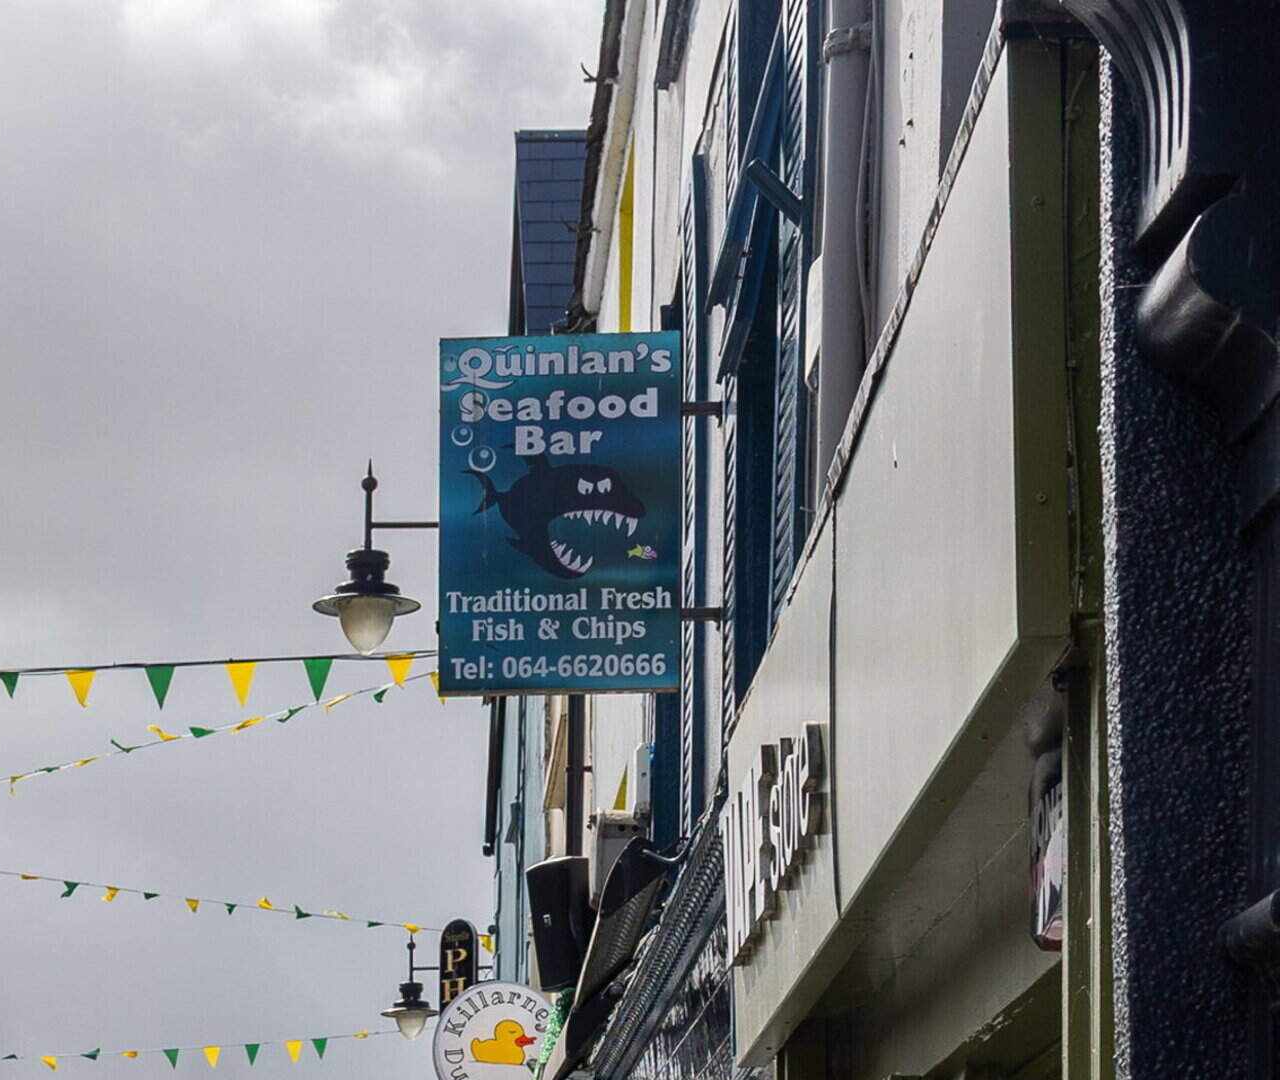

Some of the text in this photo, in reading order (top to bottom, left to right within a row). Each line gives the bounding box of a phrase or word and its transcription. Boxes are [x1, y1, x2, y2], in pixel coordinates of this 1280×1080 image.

[450, 344, 673, 389] Quinlan's
[459, 387, 659, 423] Seafood
[515, 424, 603, 456] Bar
[446, 586, 672, 614] Traditional Fresh
[471, 615, 646, 645] Fish & Chips
[451, 653, 666, 680] Tel: 064-6620666
